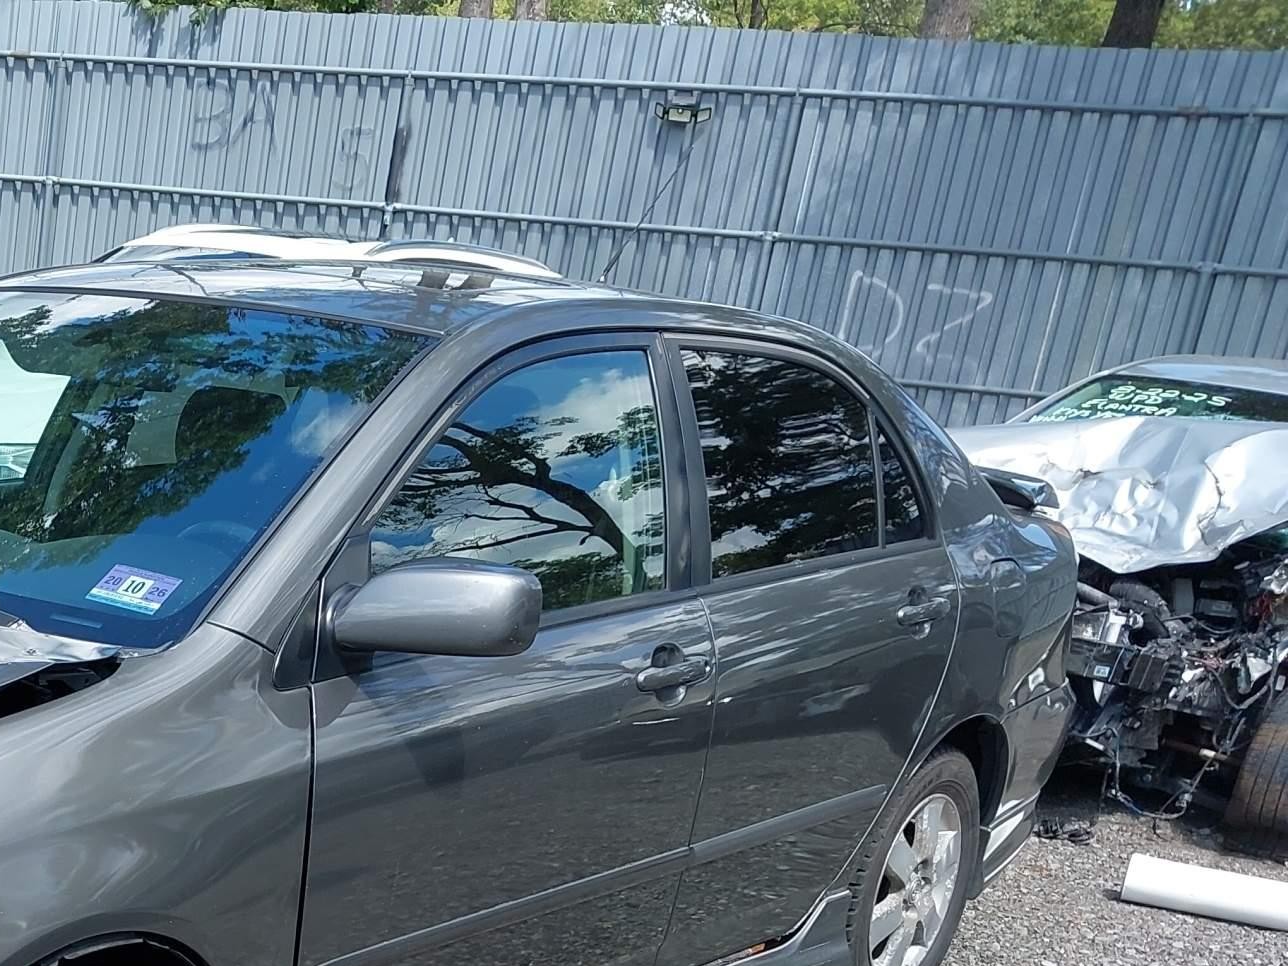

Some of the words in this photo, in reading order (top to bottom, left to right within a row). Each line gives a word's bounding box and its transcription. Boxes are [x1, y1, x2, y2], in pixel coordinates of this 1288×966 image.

[103, 575, 123, 587] 20
[122, 579, 147, 595] 10
[147, 586, 169, 598] 26
